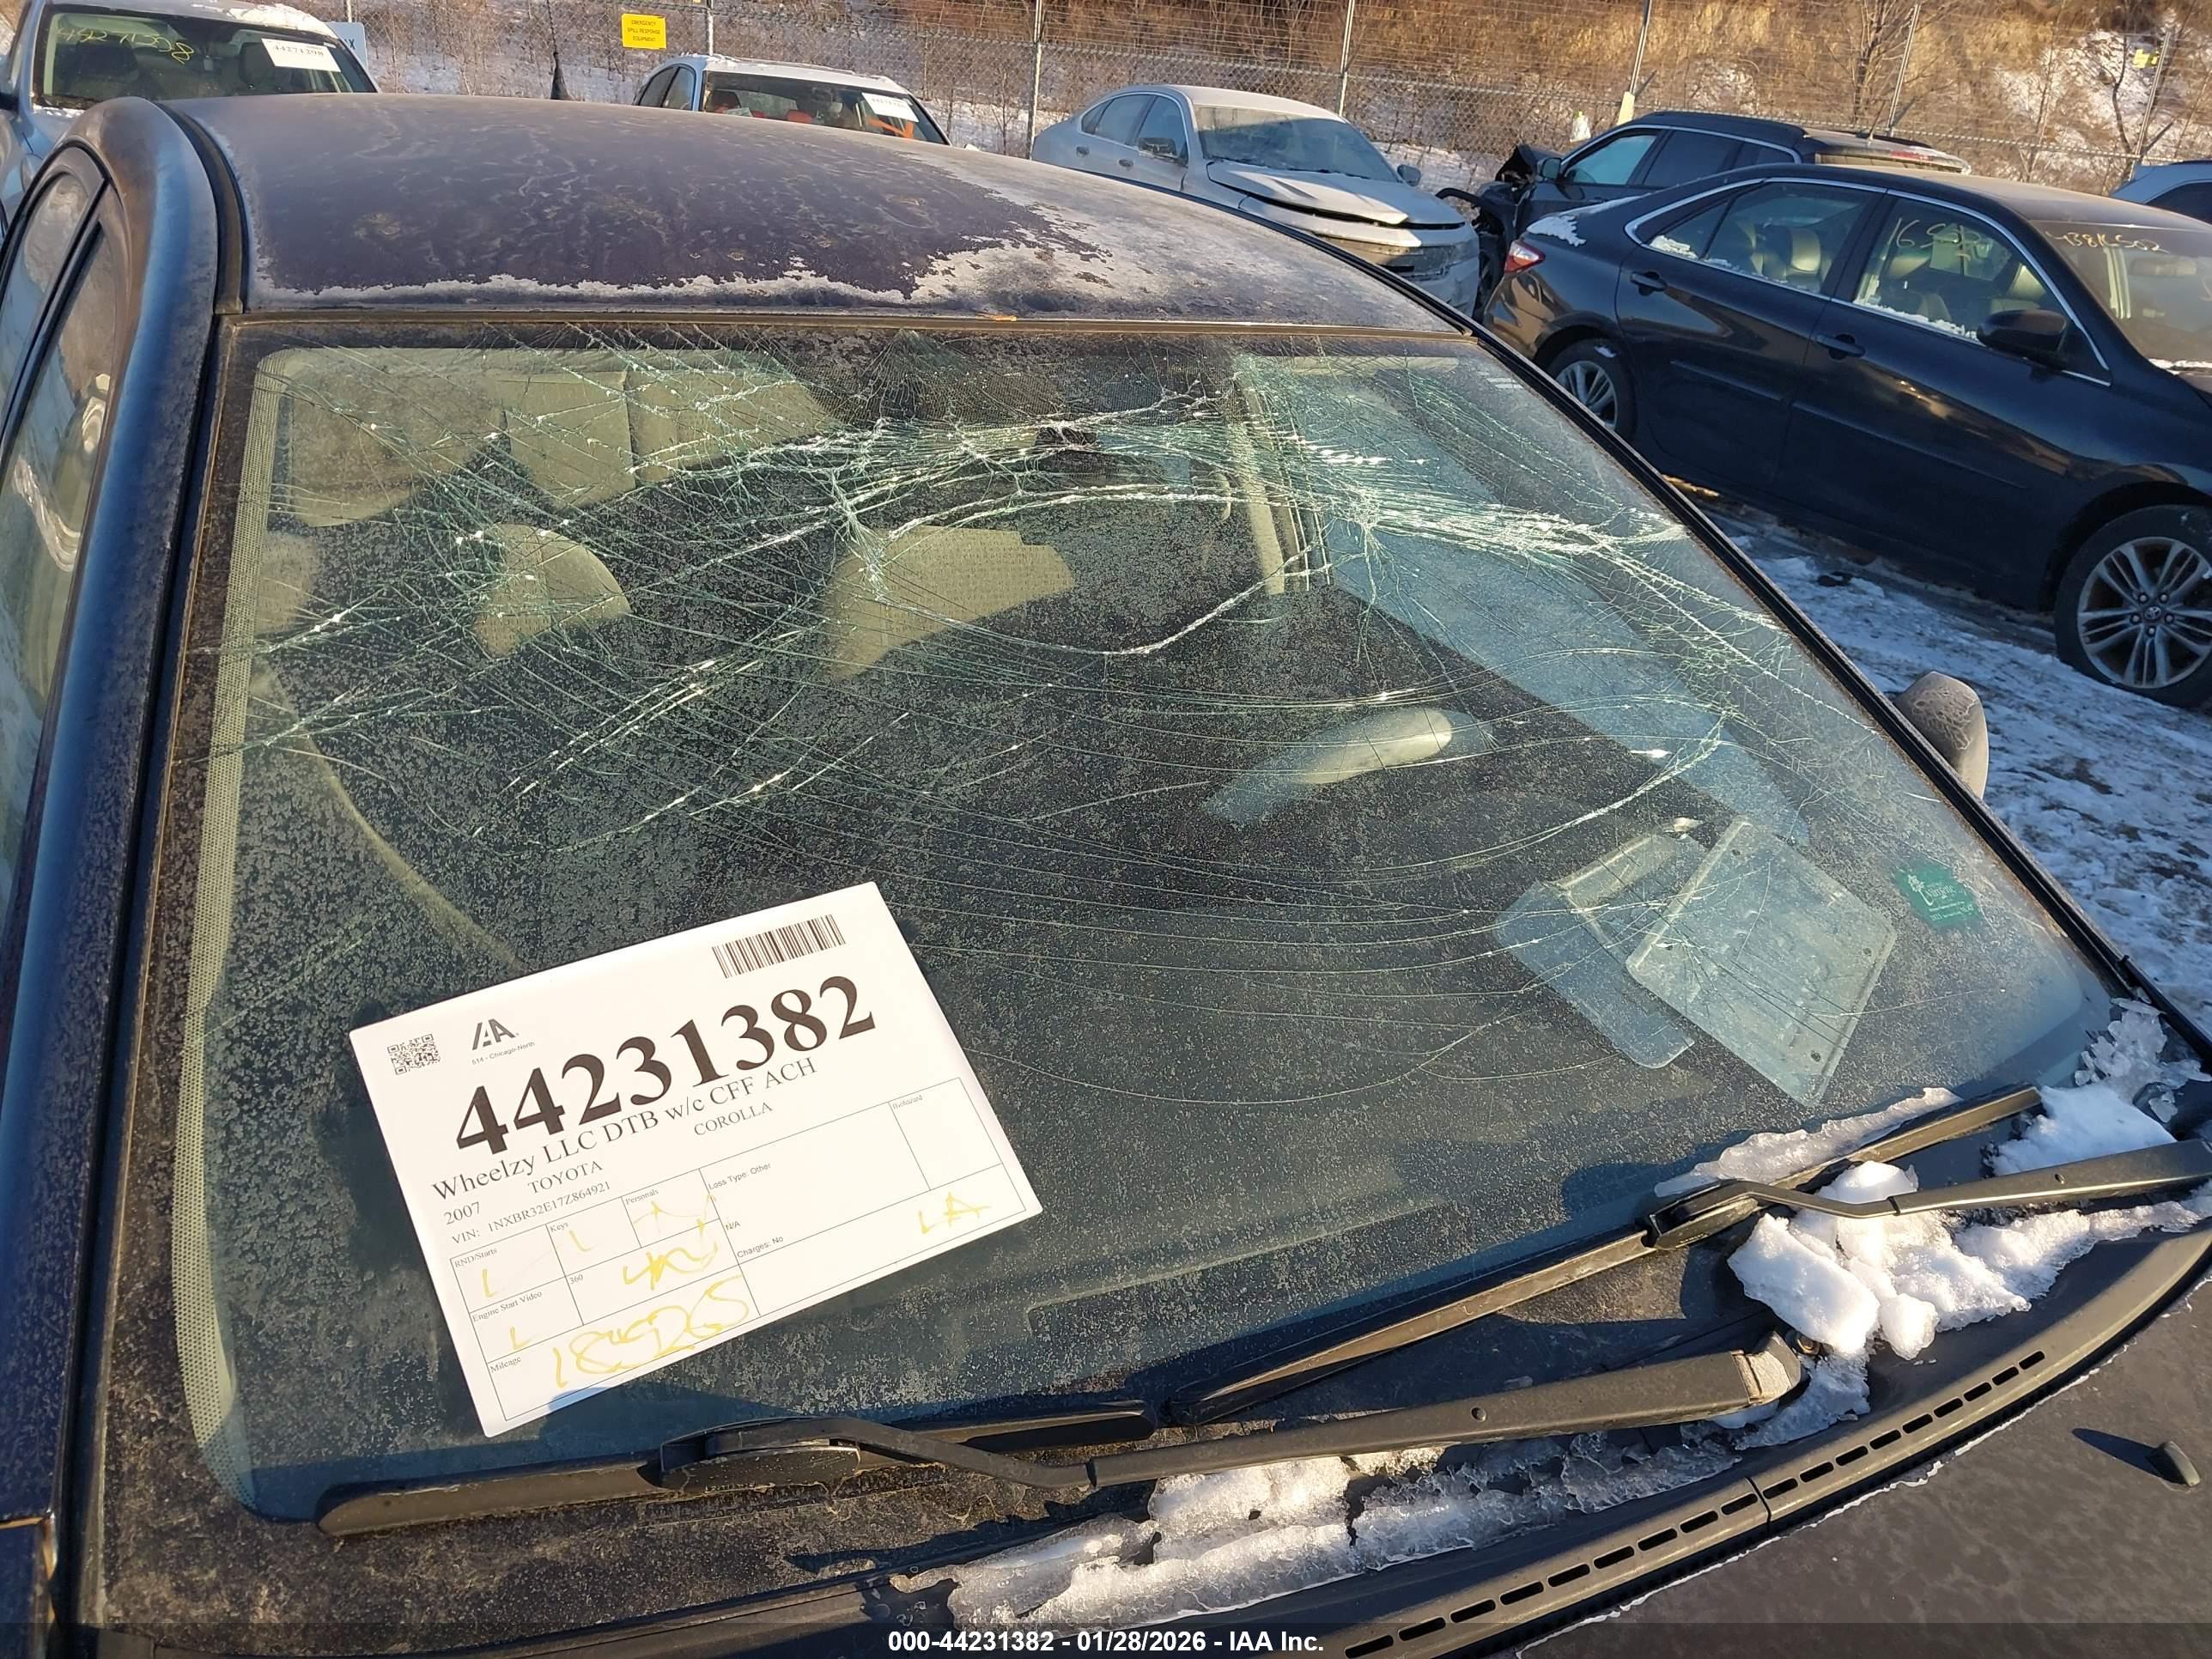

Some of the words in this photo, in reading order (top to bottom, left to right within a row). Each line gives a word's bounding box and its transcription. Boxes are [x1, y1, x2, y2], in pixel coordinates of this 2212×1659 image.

[456, 975, 876, 1155] 44231382
[431, 1155, 535, 1200] Wheelzy
[542, 1130, 598, 1164] LLC
[602, 1109, 659, 1143] DTB
[665, 1096, 705, 1121] w/c
[709, 1076, 755, 1105] CFF
[765, 1056, 817, 1089] ACH
[528, 1160, 605, 1194] TOYOTA
[694, 1102, 774, 1135] COROLLA
[708, 1178, 727, 1190] Loss
[727, 1170, 749, 1182] Type:
[750, 1162, 771, 1175] Other
[625, 1188, 659, 1206] Personals
[443, 1201, 481, 1225] 2007
[452, 1229, 481, 1245] VIN:
[488, 1181, 611, 1233] 1NXBR32E17Z864921
[549, 1220, 569, 1233] Keys
[725, 1220, 741, 1231] N/A
[453, 1248, 498, 1268] RND/Starts
[737, 1242, 771, 1258] Charges:
[772, 1236, 784, 1244] No
[568, 1274, 584, 1285] 360
[472, 1306, 499, 1323] Engine
[500, 1299, 519, 1312] Start
[520, 1291, 543, 1304] Video
[489, 1355, 521, 1374] Mileage
